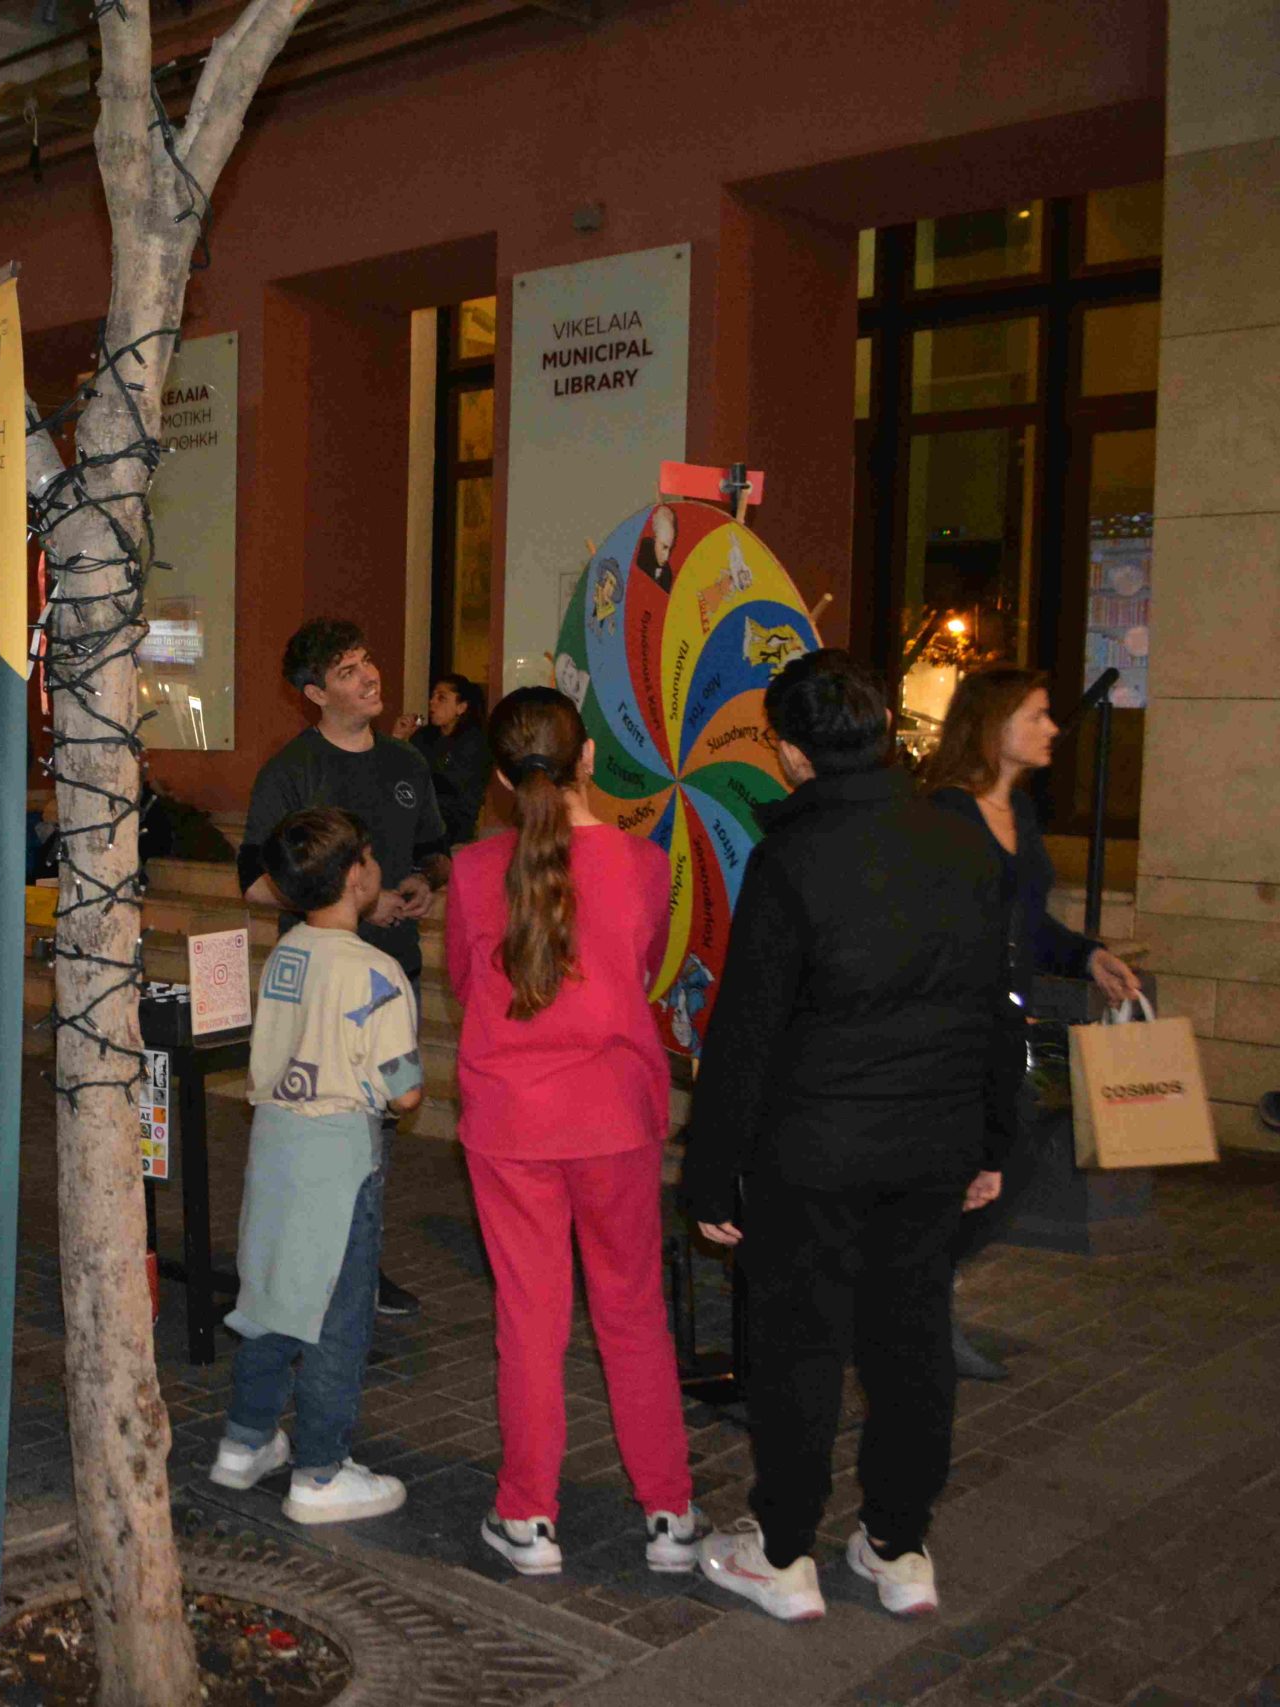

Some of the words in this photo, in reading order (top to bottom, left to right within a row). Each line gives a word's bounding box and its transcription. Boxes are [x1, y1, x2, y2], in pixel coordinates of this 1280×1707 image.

[553, 310, 643, 340] VIKELAIA
[542, 338, 653, 370] MUNICIPAL
[554, 368, 639, 396] LIBRARY
[161, 385, 209, 407] ΚΕΛΑΙΑ
[161, 407, 211, 430] ΜΟΤΙΚΗ
[1101, 1079, 1184, 1098] COSMOS
